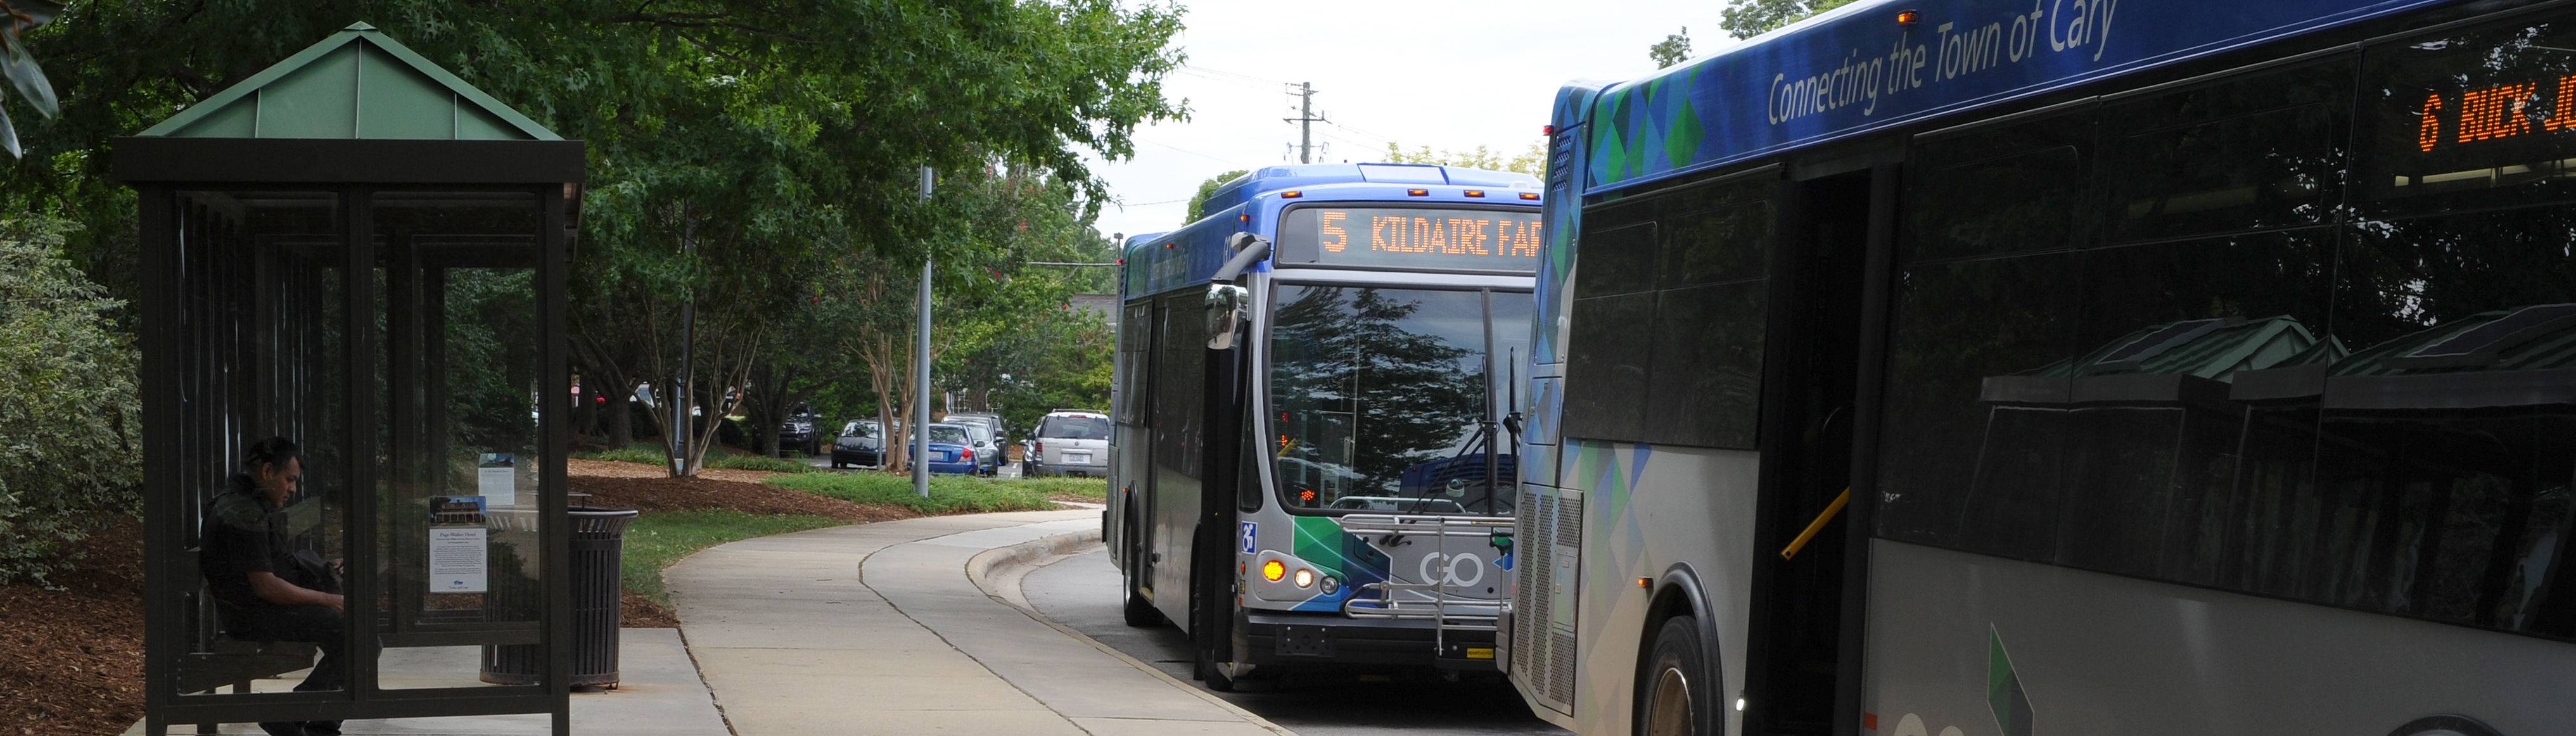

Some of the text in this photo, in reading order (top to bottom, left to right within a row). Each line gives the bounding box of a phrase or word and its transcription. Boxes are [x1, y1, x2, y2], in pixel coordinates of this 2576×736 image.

[1768, 0, 2117, 125] Connecting the Town of Cary
[2420, 94, 2442, 152] 6
[2458, 82, 2535, 143] BUCK
[1323, 212, 1348, 252] 5
[1372, 215, 1489, 255] KILDAIRE
[1420, 552, 1484, 587] GO
